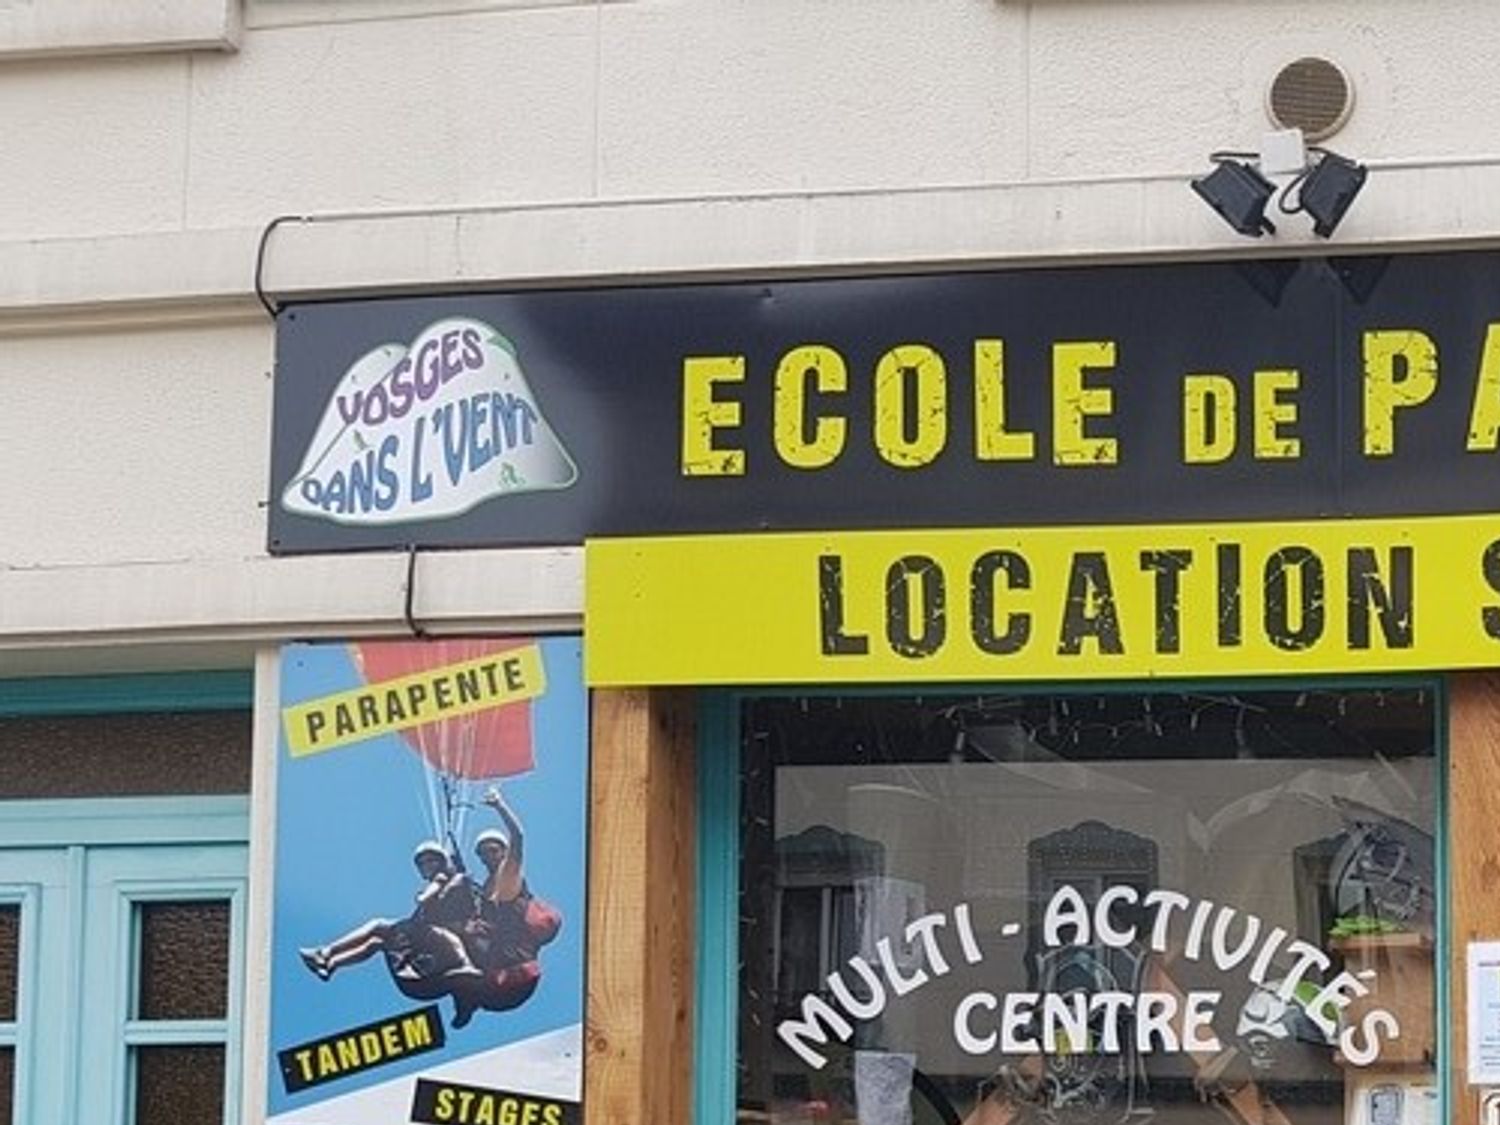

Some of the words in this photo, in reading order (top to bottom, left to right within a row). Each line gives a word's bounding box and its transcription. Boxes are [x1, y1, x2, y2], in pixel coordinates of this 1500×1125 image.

[336, 327, 485, 426] VOSGES
[681, 339, 1118, 476] ECOLE
[1183, 370, 1300, 464] DE
[301, 434, 400, 514] DANS
[818, 543, 1414, 659] LOCATION
[306, 656, 526, 744] PARAPENTE
[777, 903, 982, 1070] MULTI
[1043, 884, 1399, 1067] ACTIVITÉS
[954, 991, 1222, 1054] CENTRE
[296, 1014, 432, 1082] TANDEM
